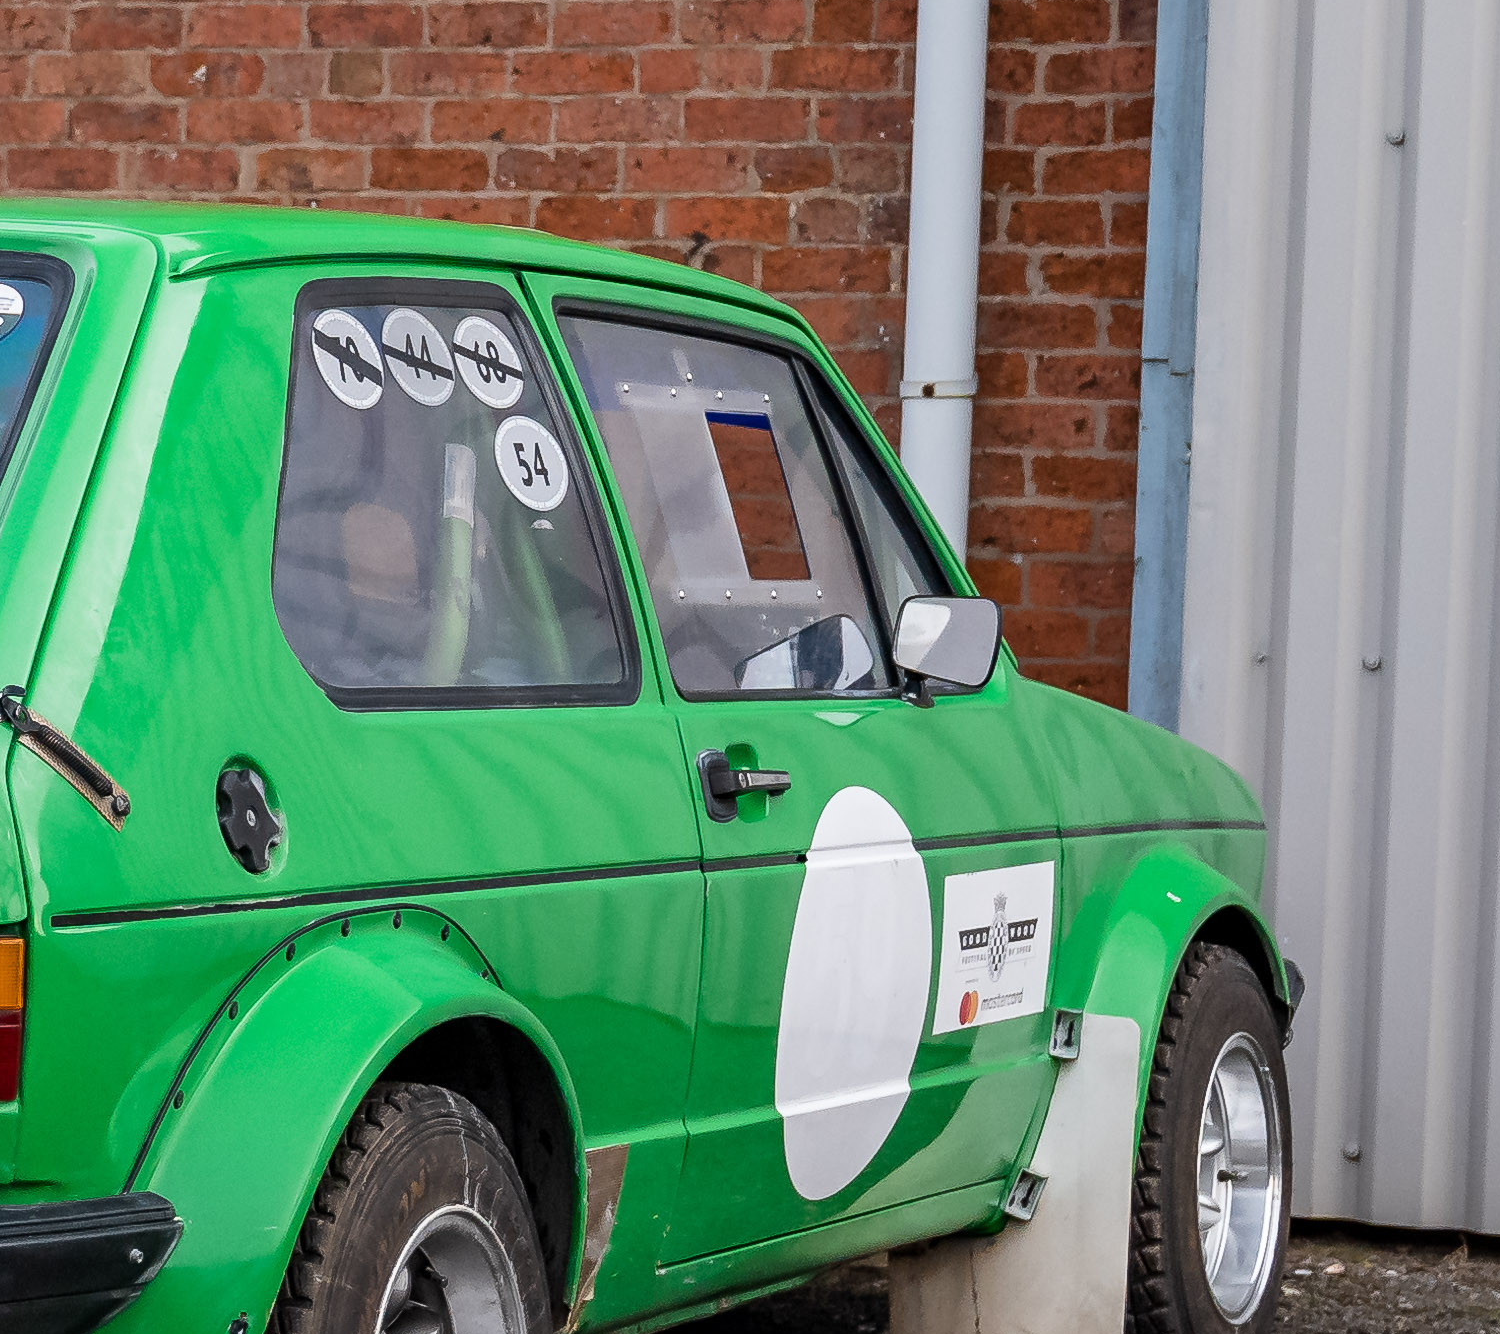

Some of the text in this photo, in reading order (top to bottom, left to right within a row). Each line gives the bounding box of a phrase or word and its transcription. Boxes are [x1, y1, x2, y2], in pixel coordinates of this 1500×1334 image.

[405, 333, 437, 380] 44
[512, 442, 550, 487] 54
[962, 923, 1035, 947] GOOD WOOD
